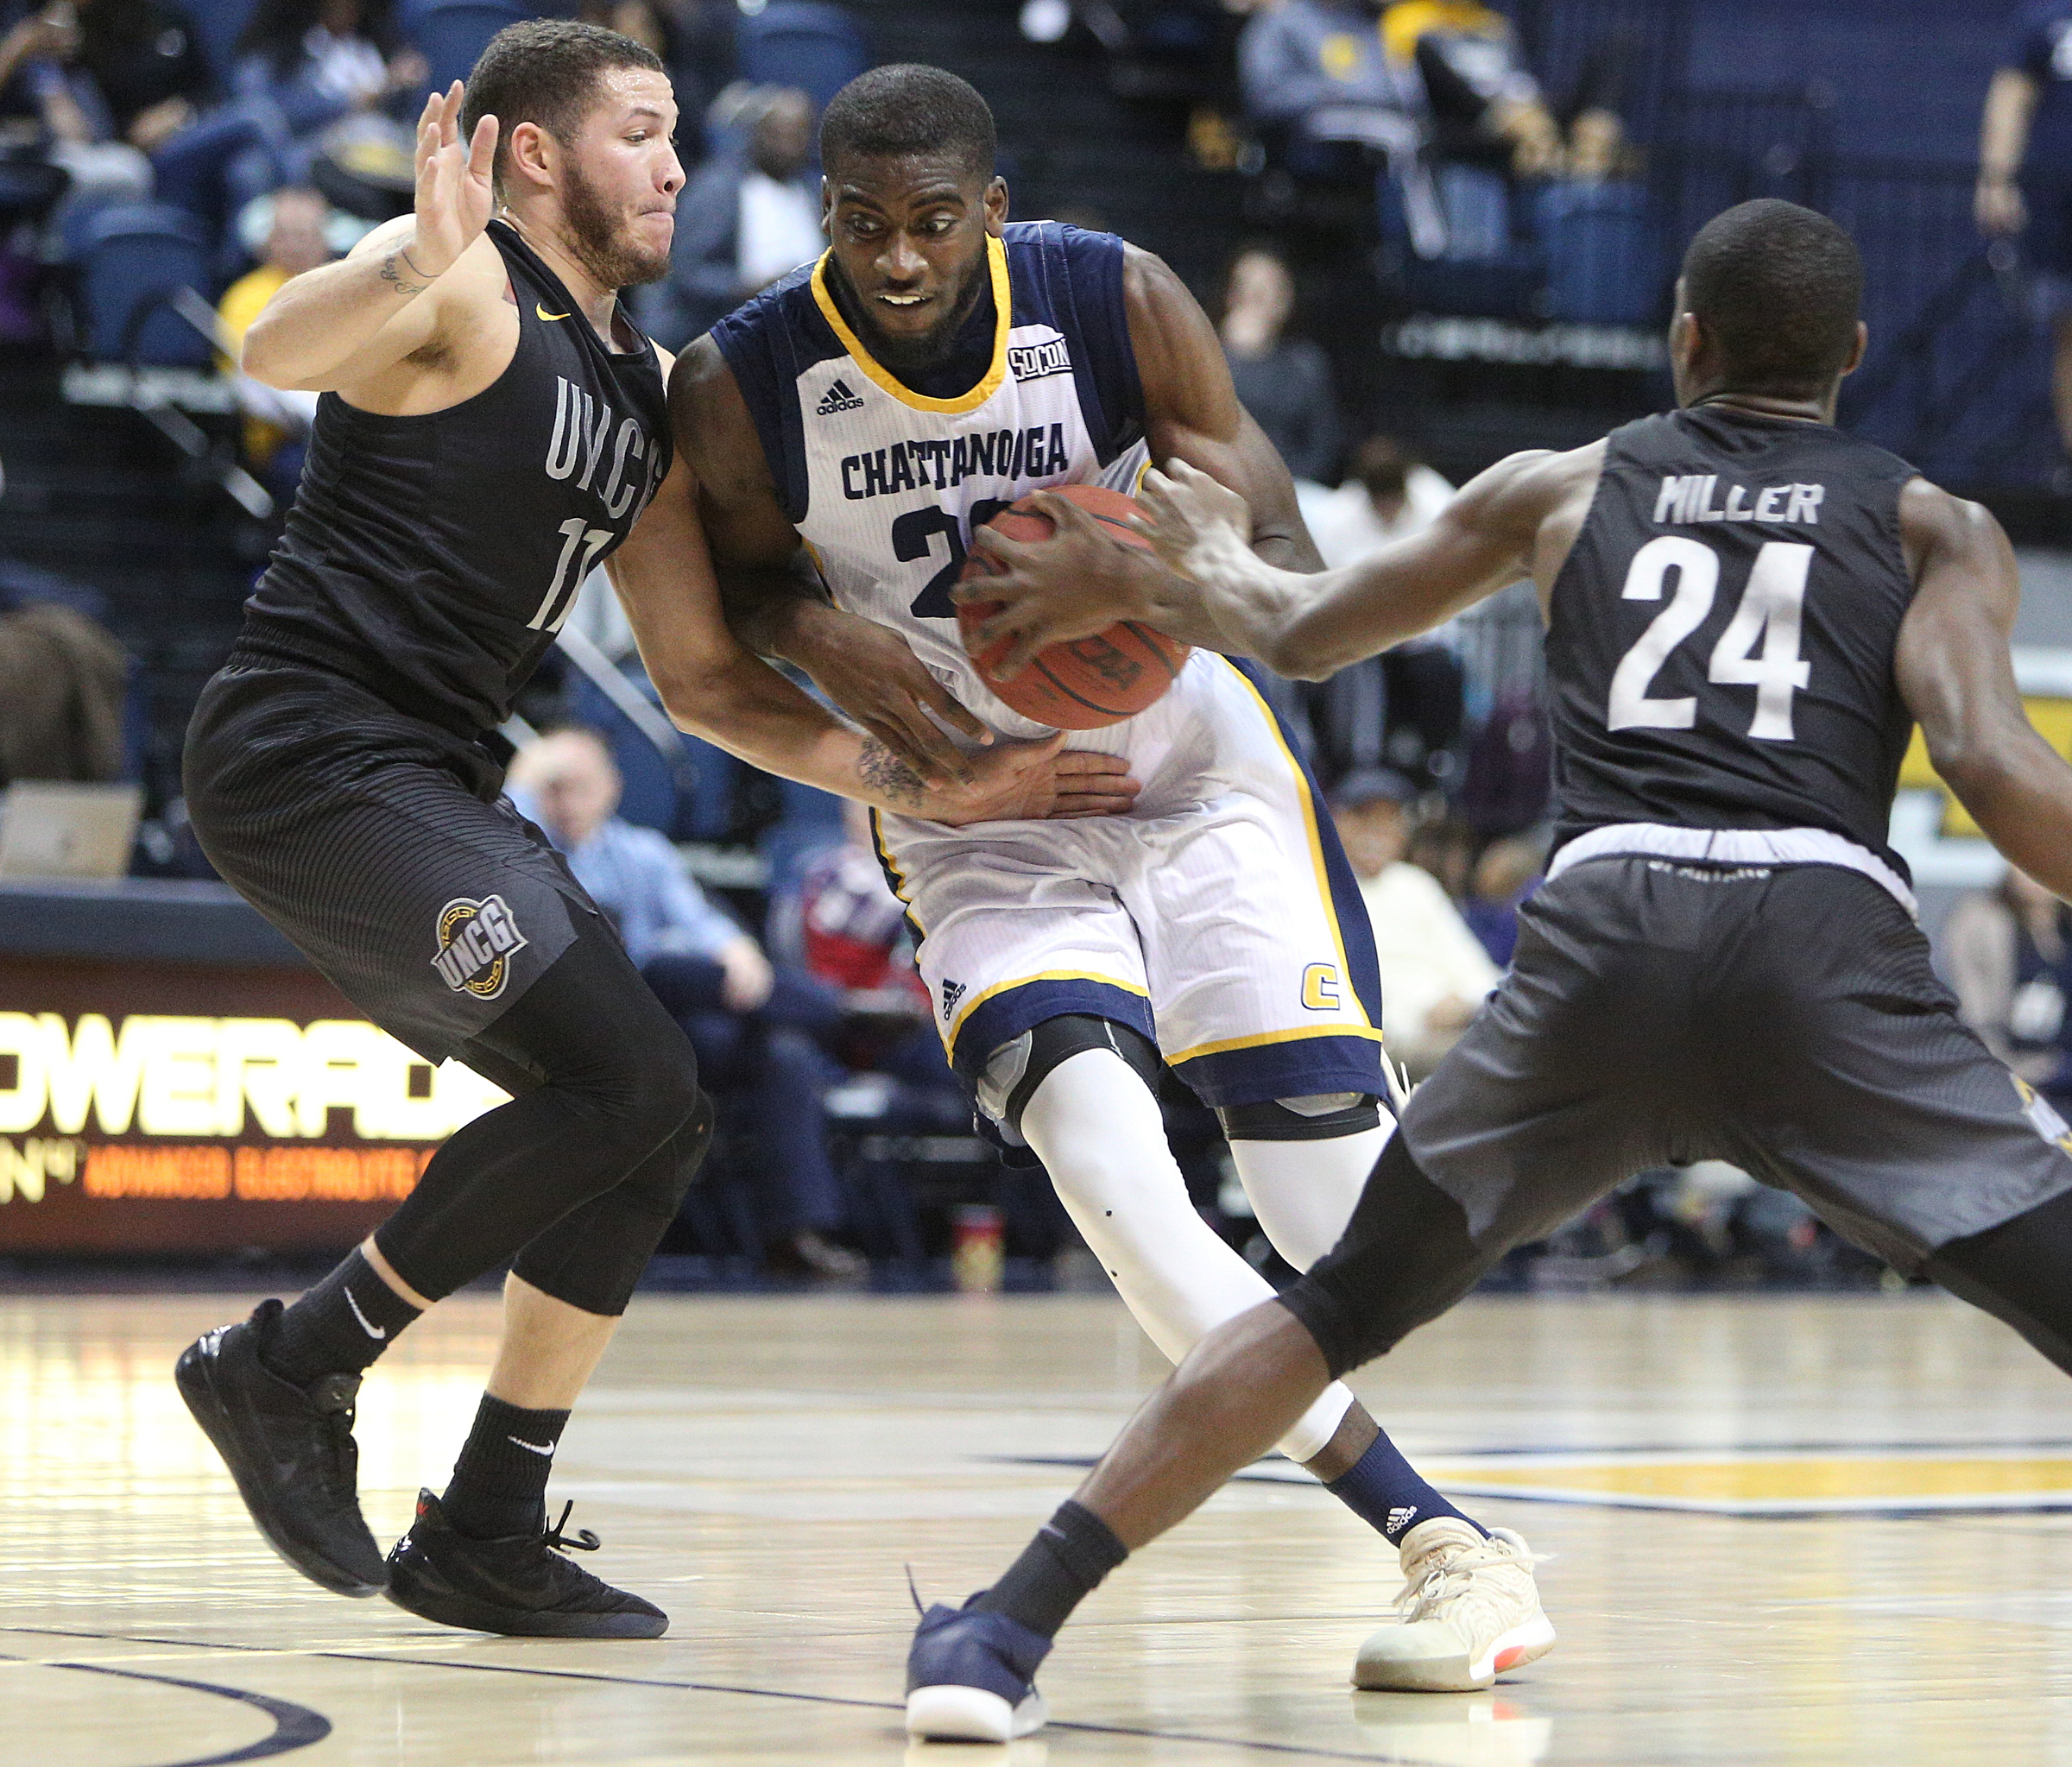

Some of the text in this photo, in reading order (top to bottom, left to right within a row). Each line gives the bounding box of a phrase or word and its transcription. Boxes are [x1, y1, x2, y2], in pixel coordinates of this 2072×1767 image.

[817, 398, 864, 416] adidas
[1653, 475, 1825, 524] MILLER
[526, 518, 614, 633] 11
[892, 497, 1014, 618] 2
[1608, 535, 1815, 741] 24
[436, 903, 515, 987] UNCG
[944, 983, 966, 1020] adidas
[1301, 962, 1340, 1011] C
[1387, 1505, 1418, 1534] adidas
